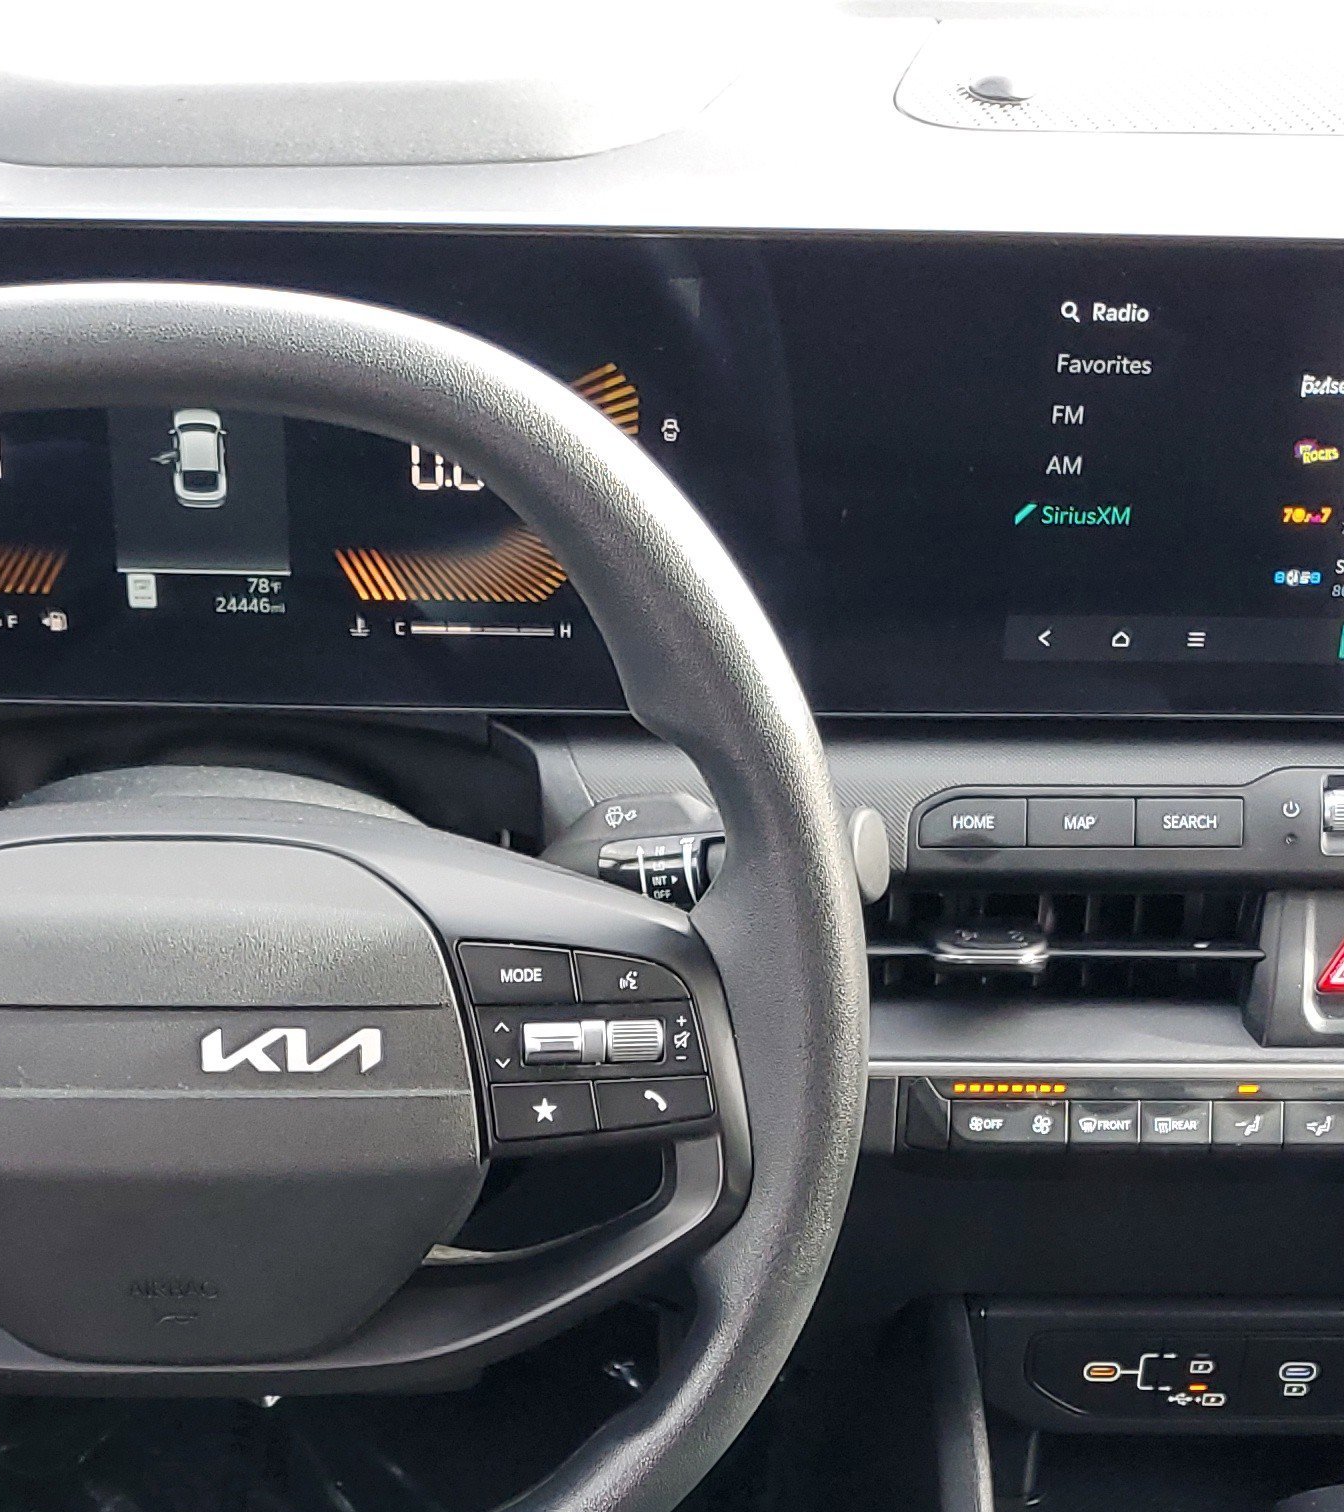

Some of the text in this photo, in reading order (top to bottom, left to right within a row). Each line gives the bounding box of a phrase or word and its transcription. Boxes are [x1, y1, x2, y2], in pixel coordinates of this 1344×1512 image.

[1092, 302, 1150, 323] Radio
[1057, 353, 1152, 375] Favorites
[1052, 405, 1084, 425] FM
[1045, 455, 1083, 475] AM
[1041, 505, 1131, 525] SiriusXM
[7, 614, 18, 629] F
[559, 624, 572, 639] H
[952, 814, 995, 830] HOME
[1064, 814, 1096, 830] MAP
[1163, 814, 1217, 829] SEARCH
[500, 967, 543, 983] MODE
[981, 1118, 1004, 1130] OFF
[1095, 1119, 1132, 1131] FRONT
[1169, 1117, 1199, 1132] REAR
